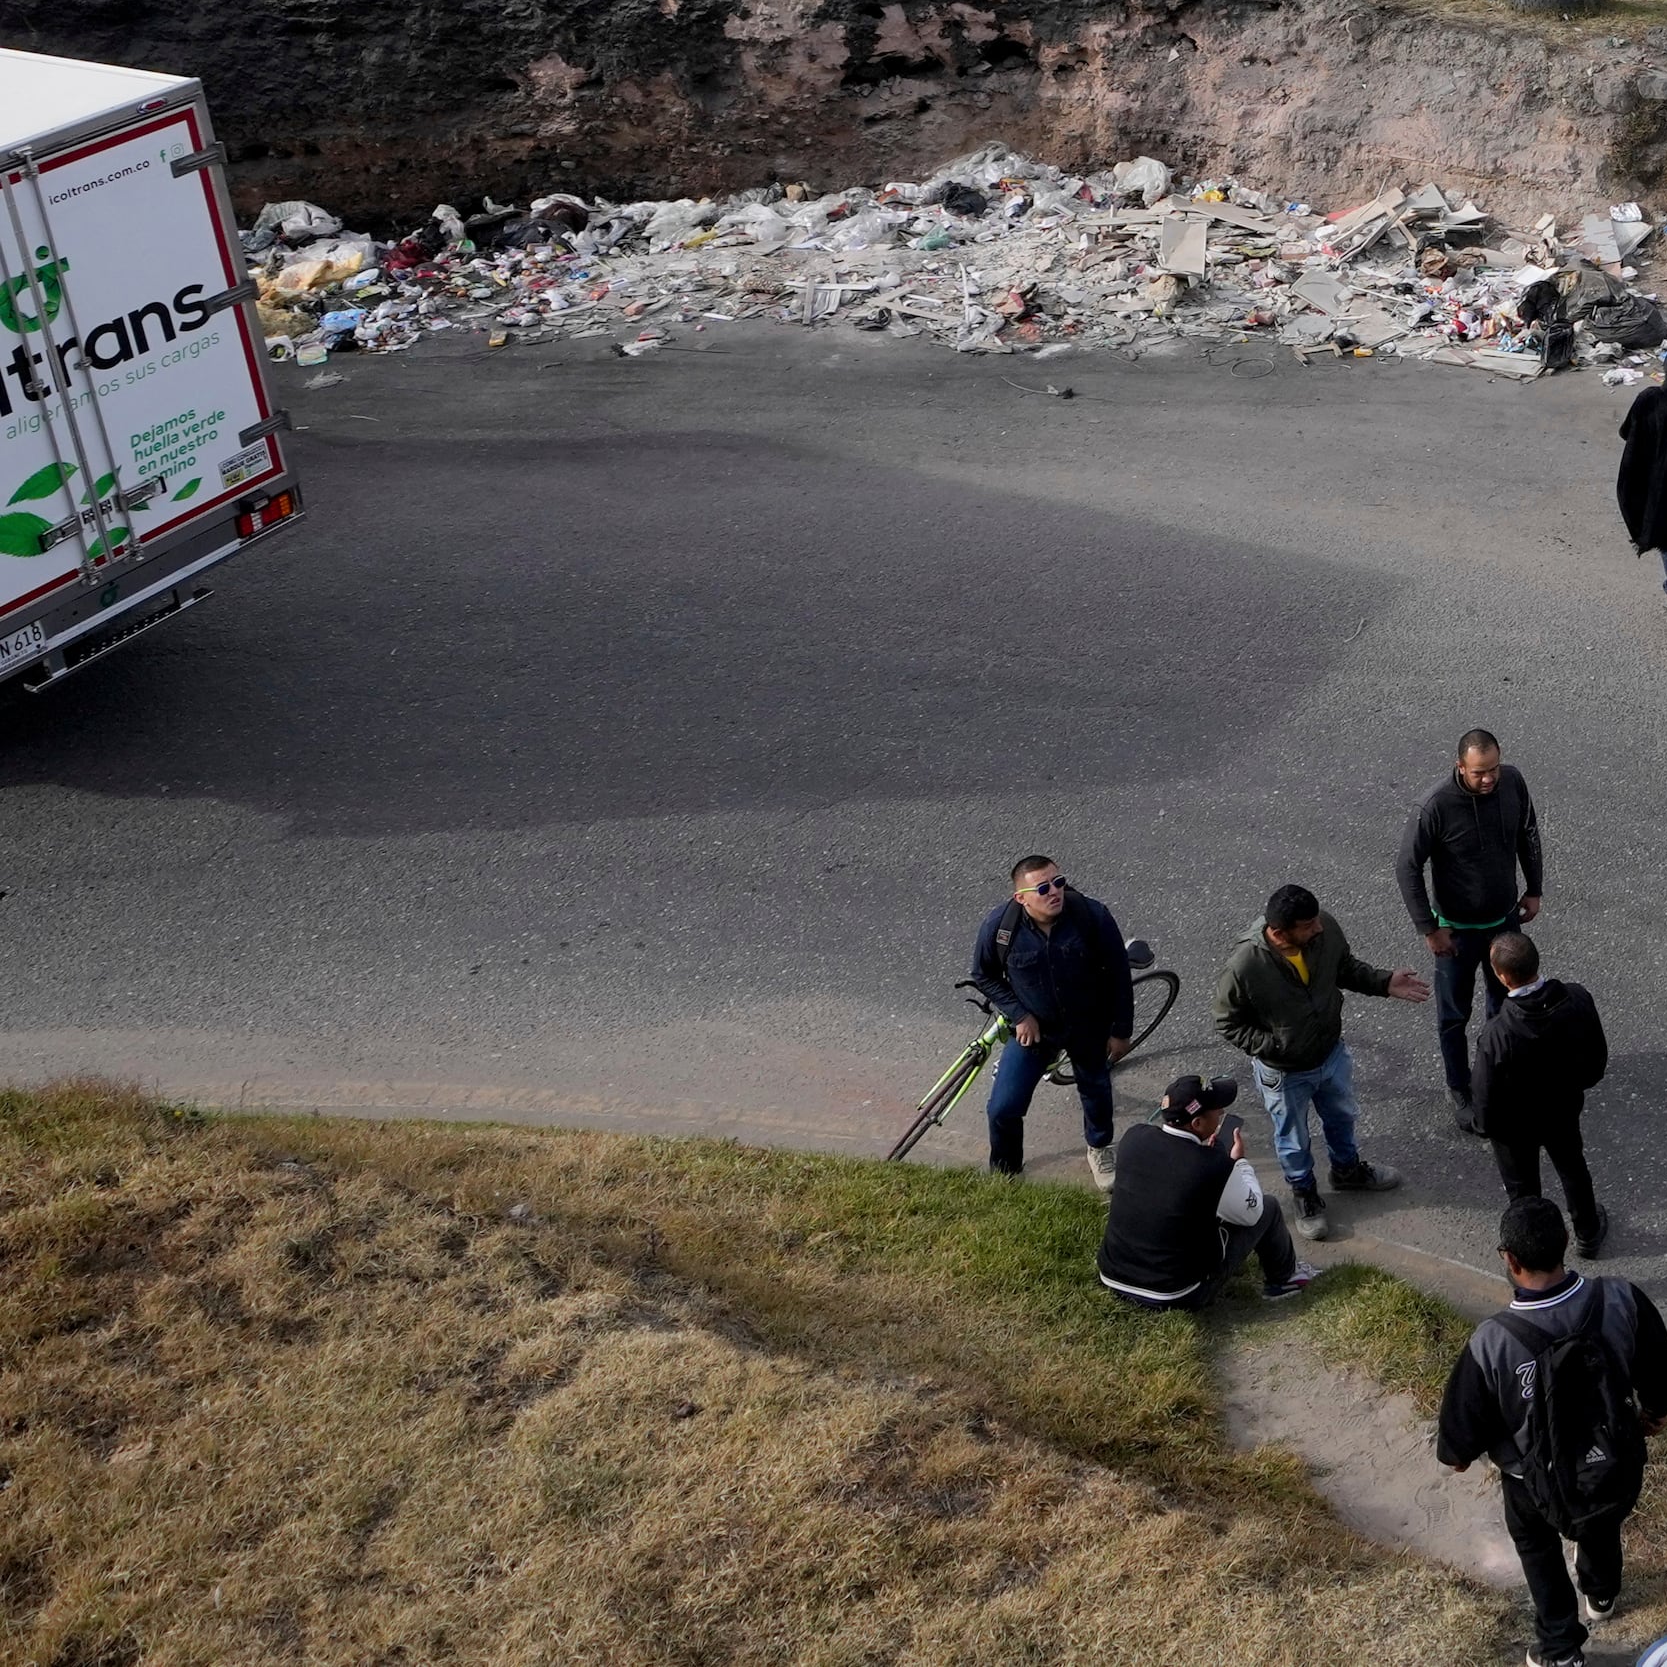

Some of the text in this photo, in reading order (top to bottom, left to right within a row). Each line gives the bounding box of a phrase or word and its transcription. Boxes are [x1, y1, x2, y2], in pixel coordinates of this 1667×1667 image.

[48, 159, 151, 205] icoltrans.com.co
[125, 360, 156, 385] sus
[160, 332, 221, 369] cargas
[130, 409, 196, 448] Dejamos
[134, 410, 226, 463] huella verde
[138, 429, 218, 476] en nuestro
[14, 626, 42, 651] 618
